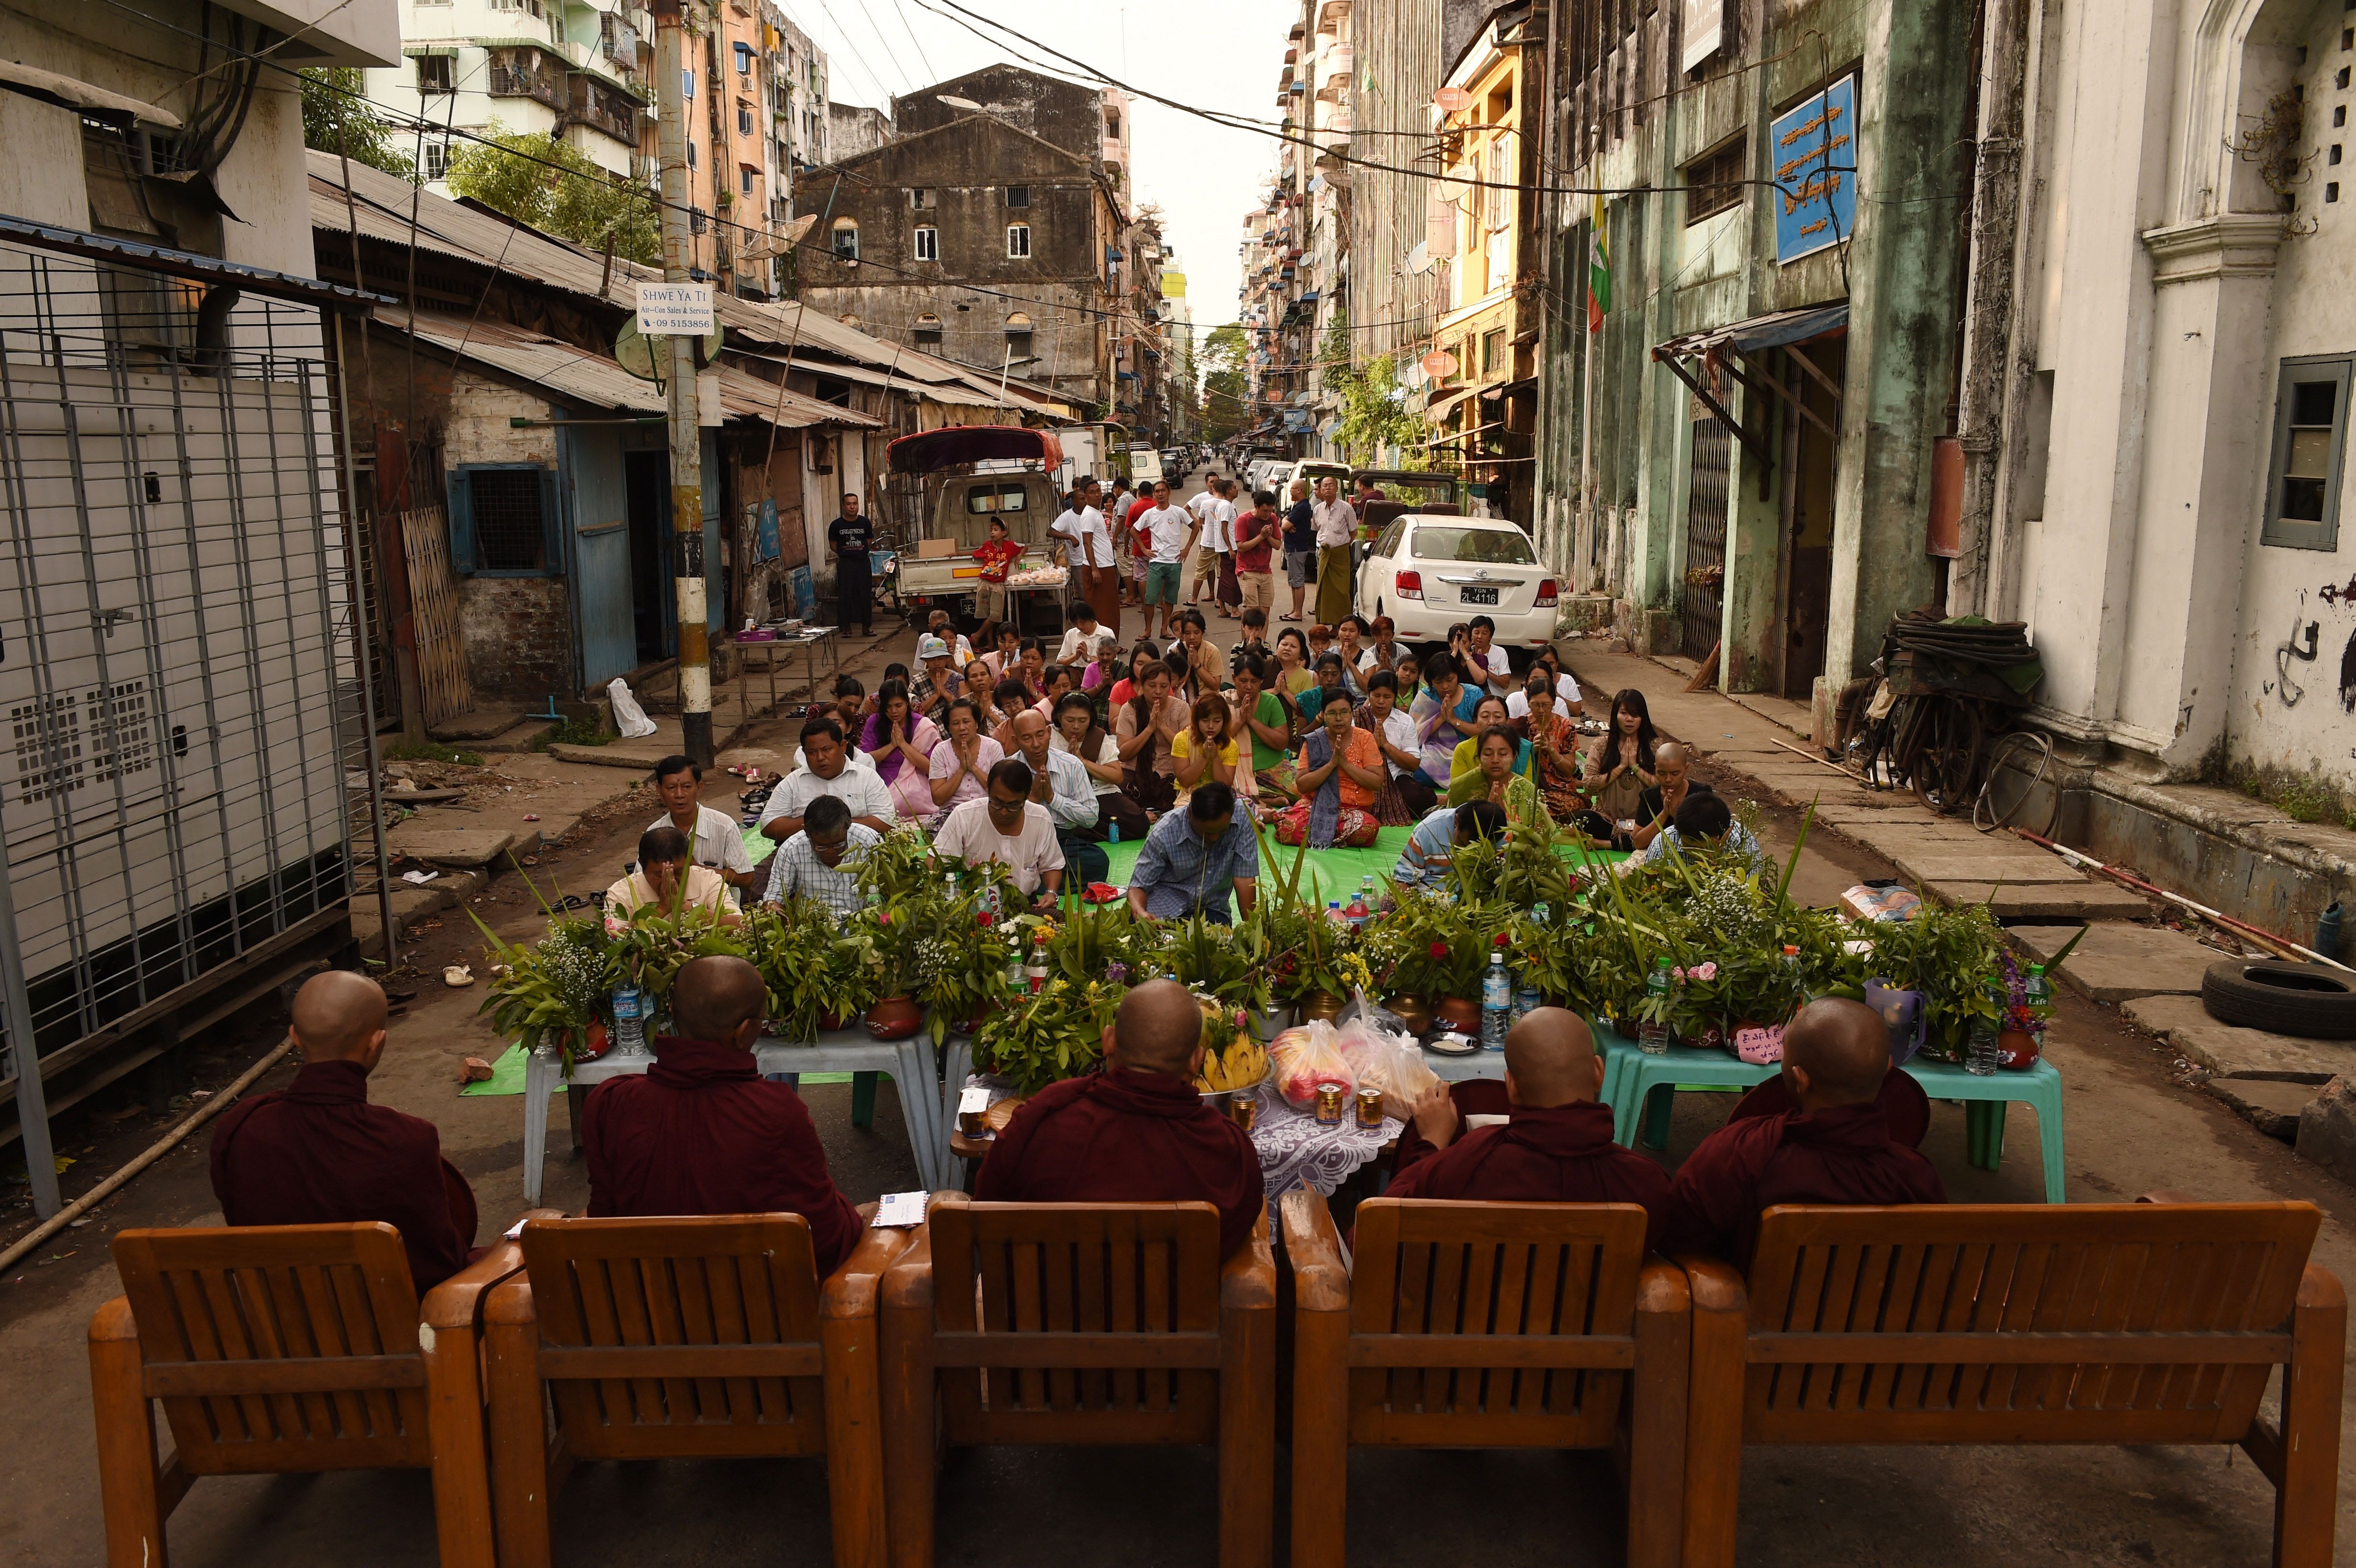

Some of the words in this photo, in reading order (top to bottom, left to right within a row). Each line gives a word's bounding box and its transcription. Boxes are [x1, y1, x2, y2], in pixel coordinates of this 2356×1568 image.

[643, 289, 674, 301] SHWE
[677, 290, 691, 301] YA
[695, 291, 706, 302] TI
[671, 320, 709, 328] 5153856
[1462, 592, 1496, 604] 2L-4116
[963, 604, 975, 613] 3E-
[2028, 996, 2047, 1005] Life
